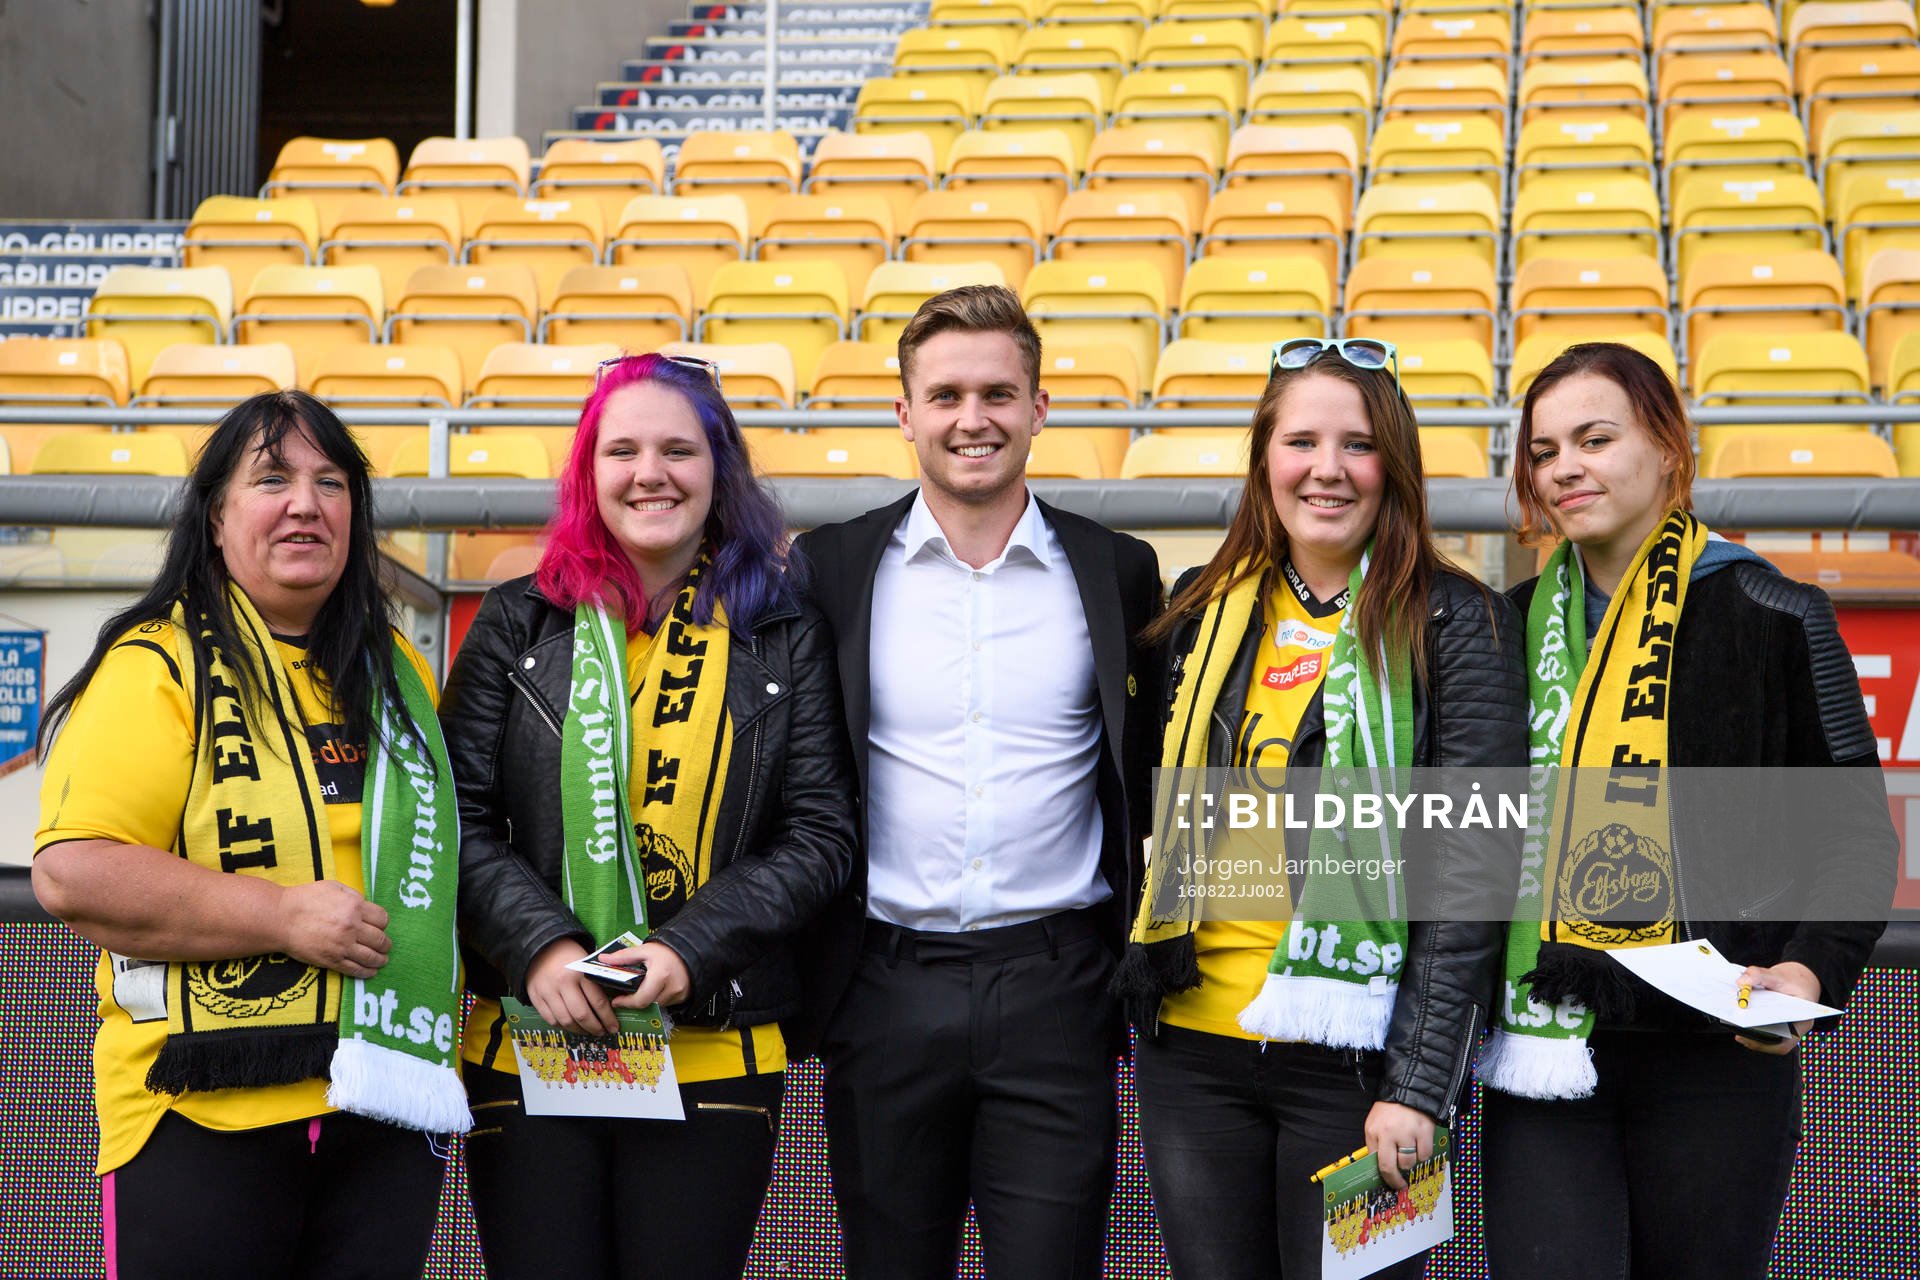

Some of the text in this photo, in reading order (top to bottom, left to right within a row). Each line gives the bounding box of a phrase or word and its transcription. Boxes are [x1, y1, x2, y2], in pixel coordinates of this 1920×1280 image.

[1284, 561, 1311, 601] BORÅS
[1268, 660, 1320, 685] STAPLES
[643, 749, 680, 808] IF
[216, 808, 277, 874] IF
[354, 979, 452, 1053] bt.se
